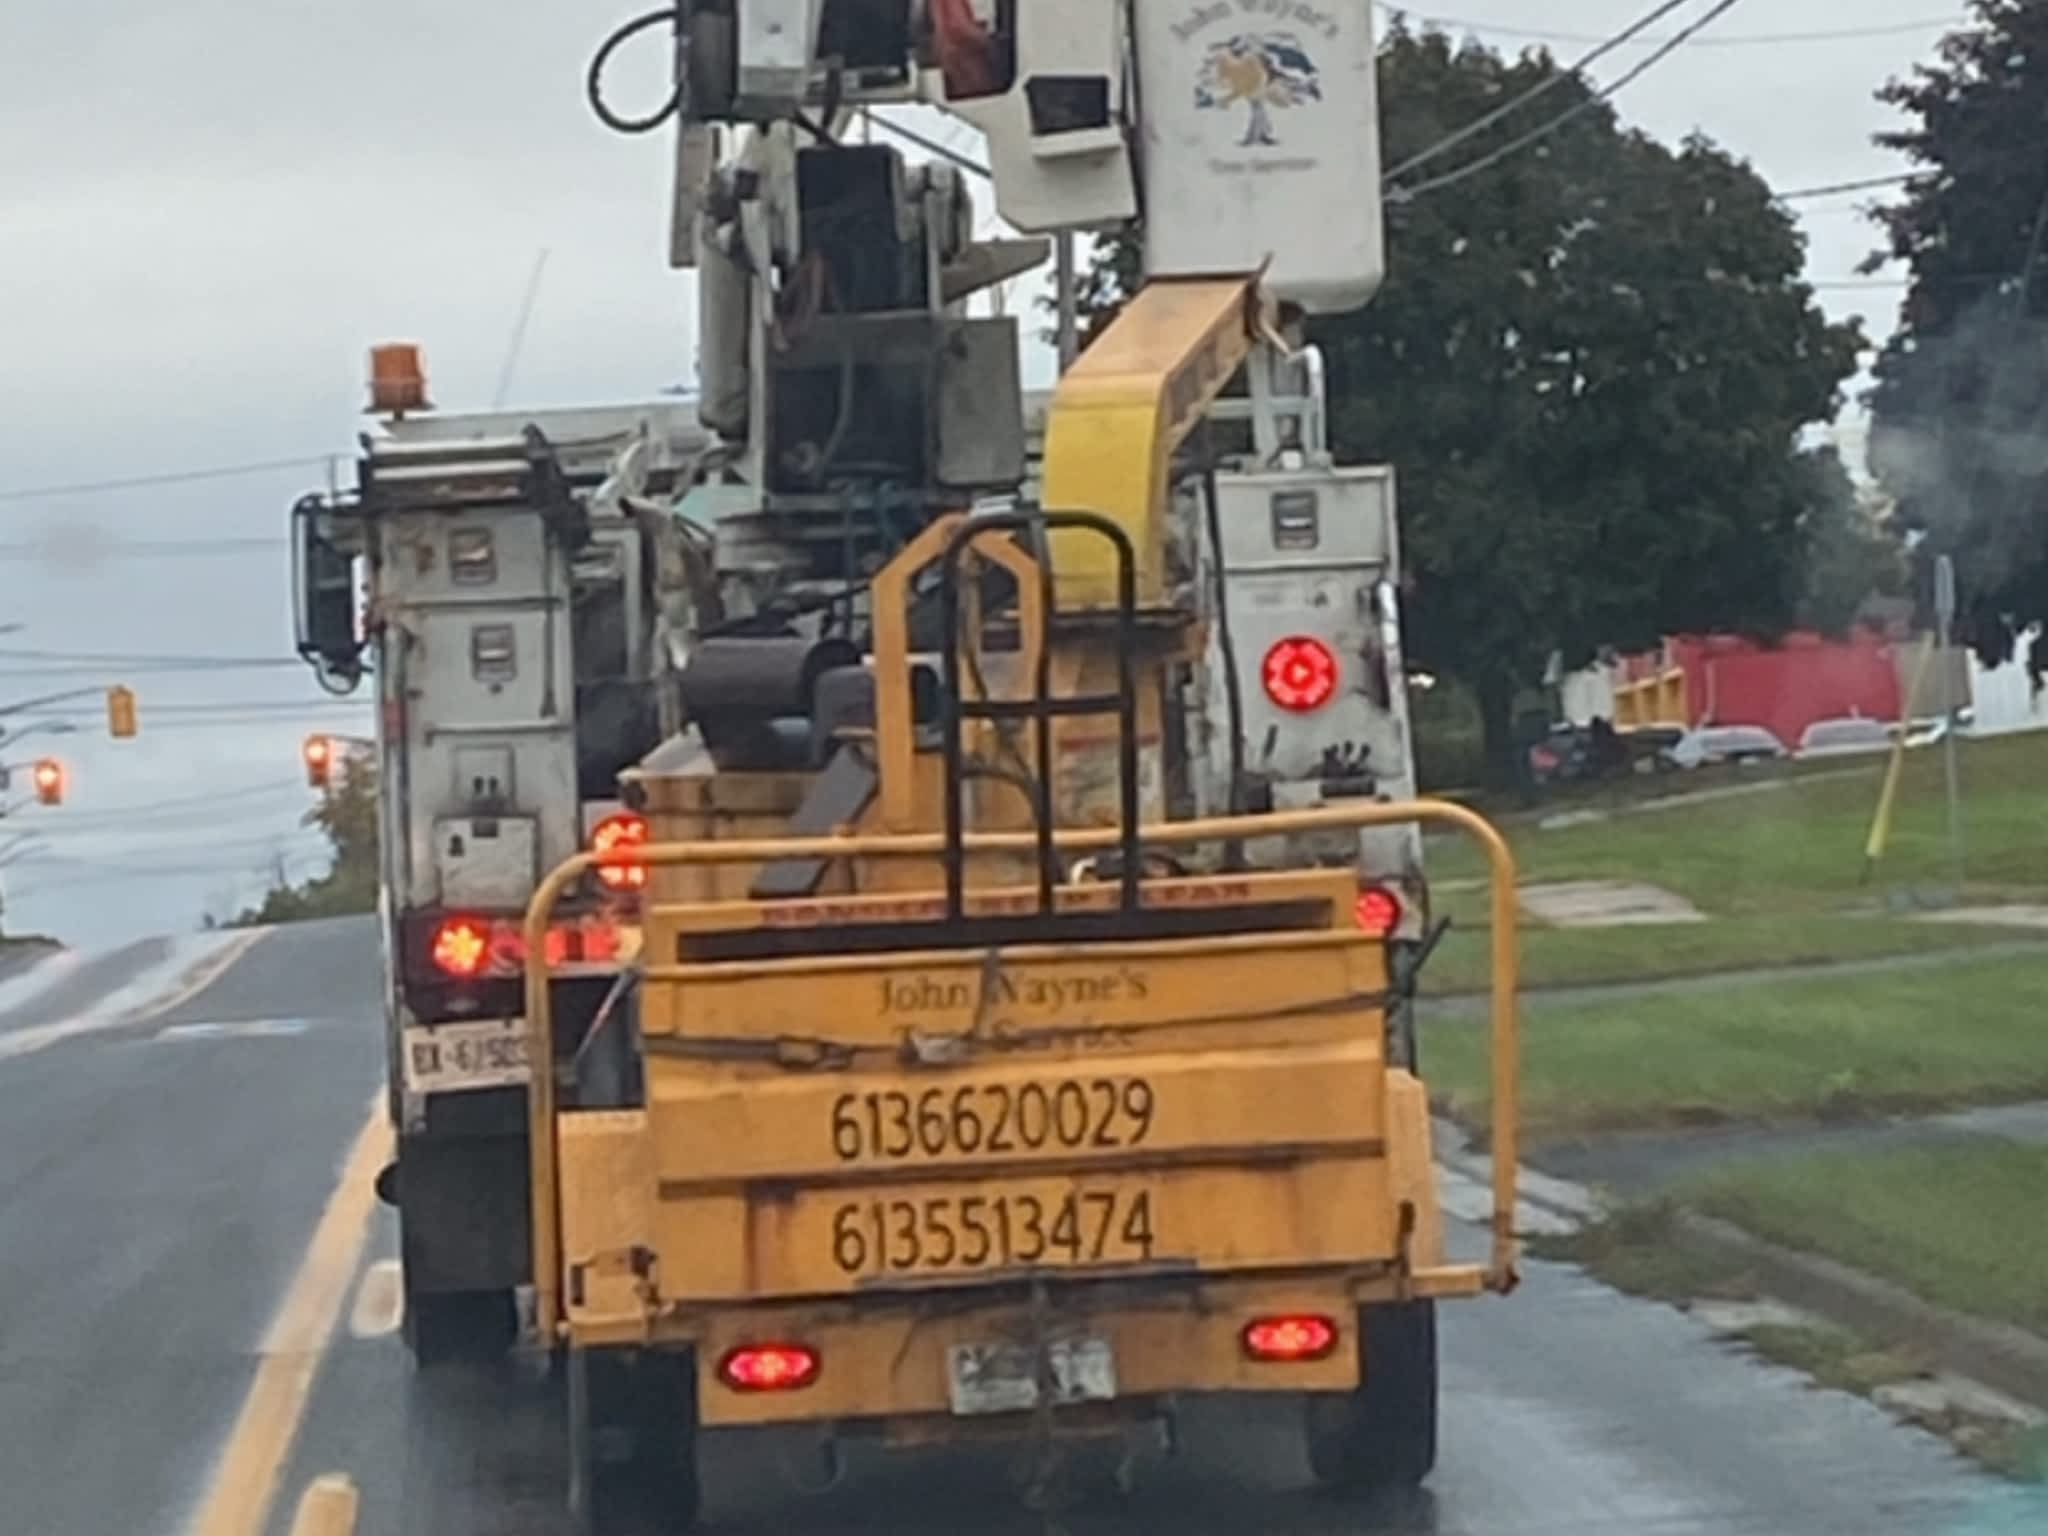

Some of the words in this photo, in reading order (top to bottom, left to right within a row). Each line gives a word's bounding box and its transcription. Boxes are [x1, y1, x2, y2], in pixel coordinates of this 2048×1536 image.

[877, 974, 970, 1016] John
[832, 1077, 1155, 1161] 6136620029
[832, 1189, 1155, 1273] 6135513474
